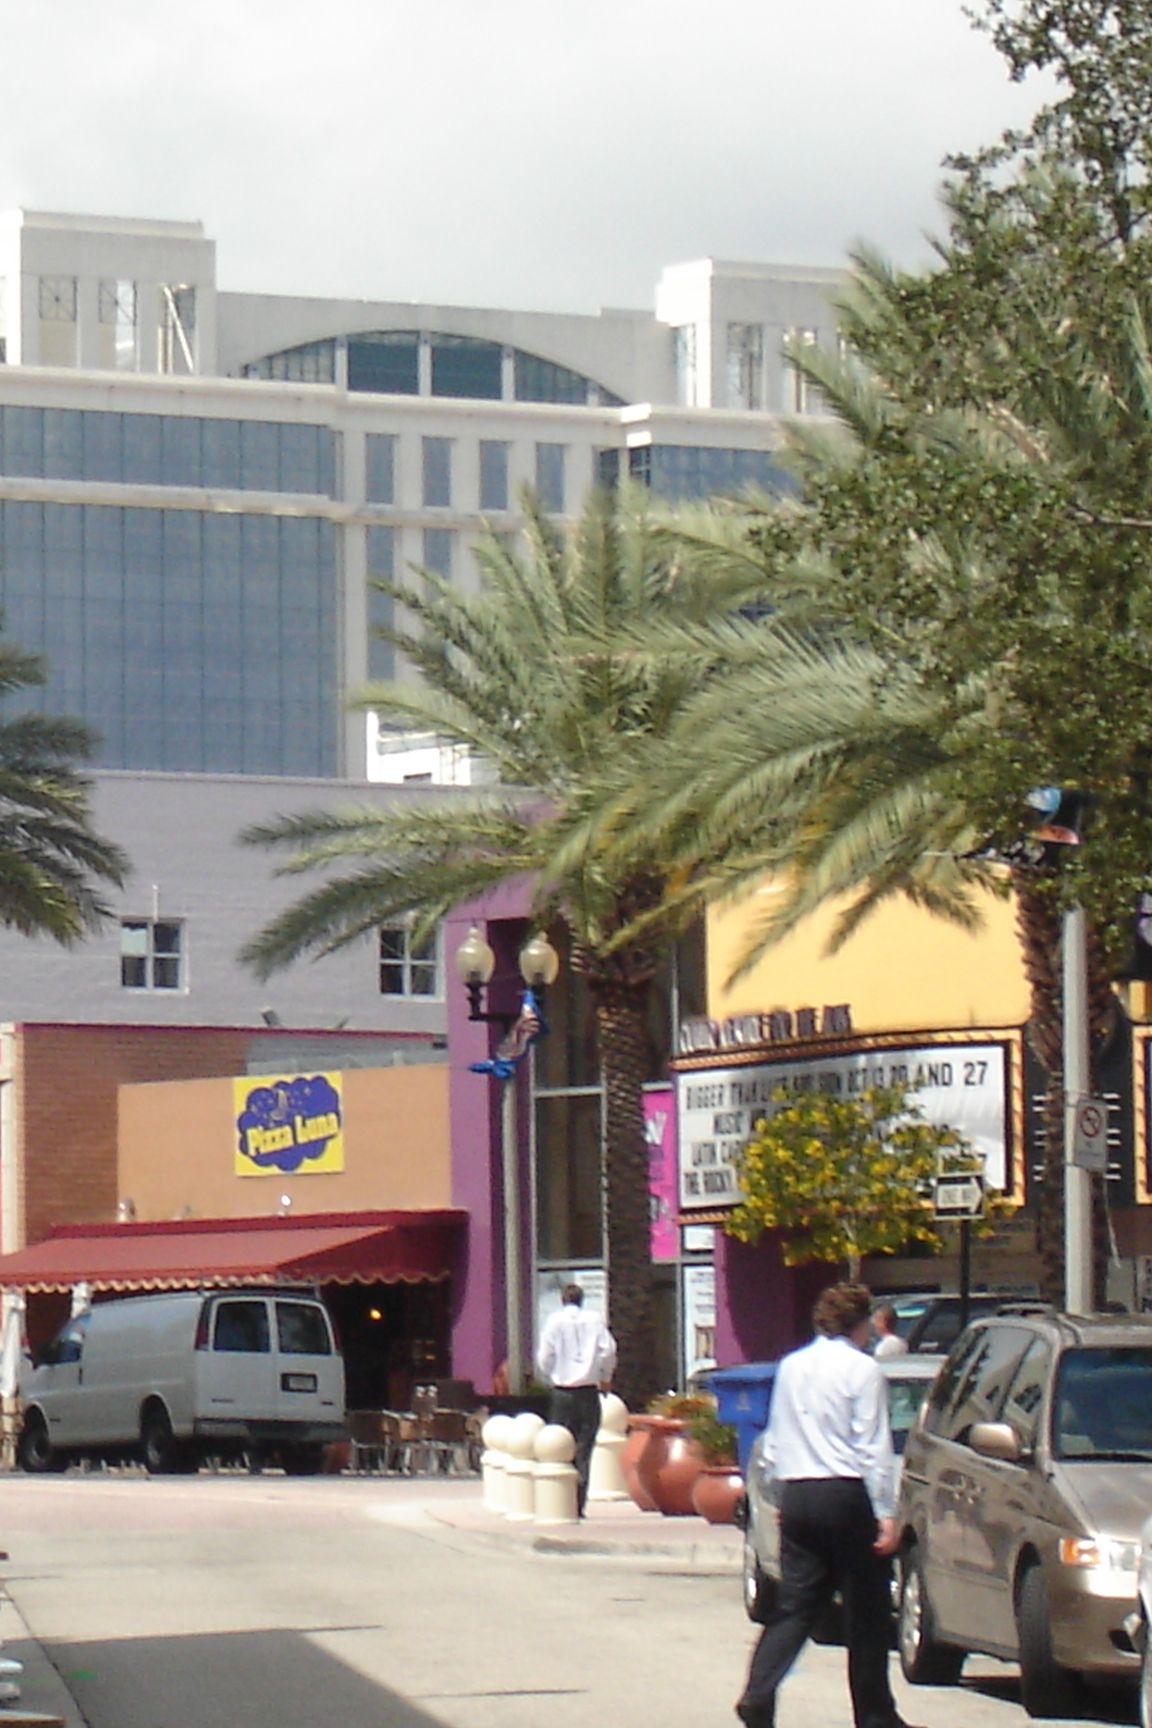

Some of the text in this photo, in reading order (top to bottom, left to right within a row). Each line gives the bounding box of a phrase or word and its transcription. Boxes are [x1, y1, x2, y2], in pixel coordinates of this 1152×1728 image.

[686, 1084, 725, 1110] BIGGER
[914, 1061, 954, 1092] AND
[963, 1061, 989, 1087] 27
[246, 1111, 339, 1158] Pizza Luna
